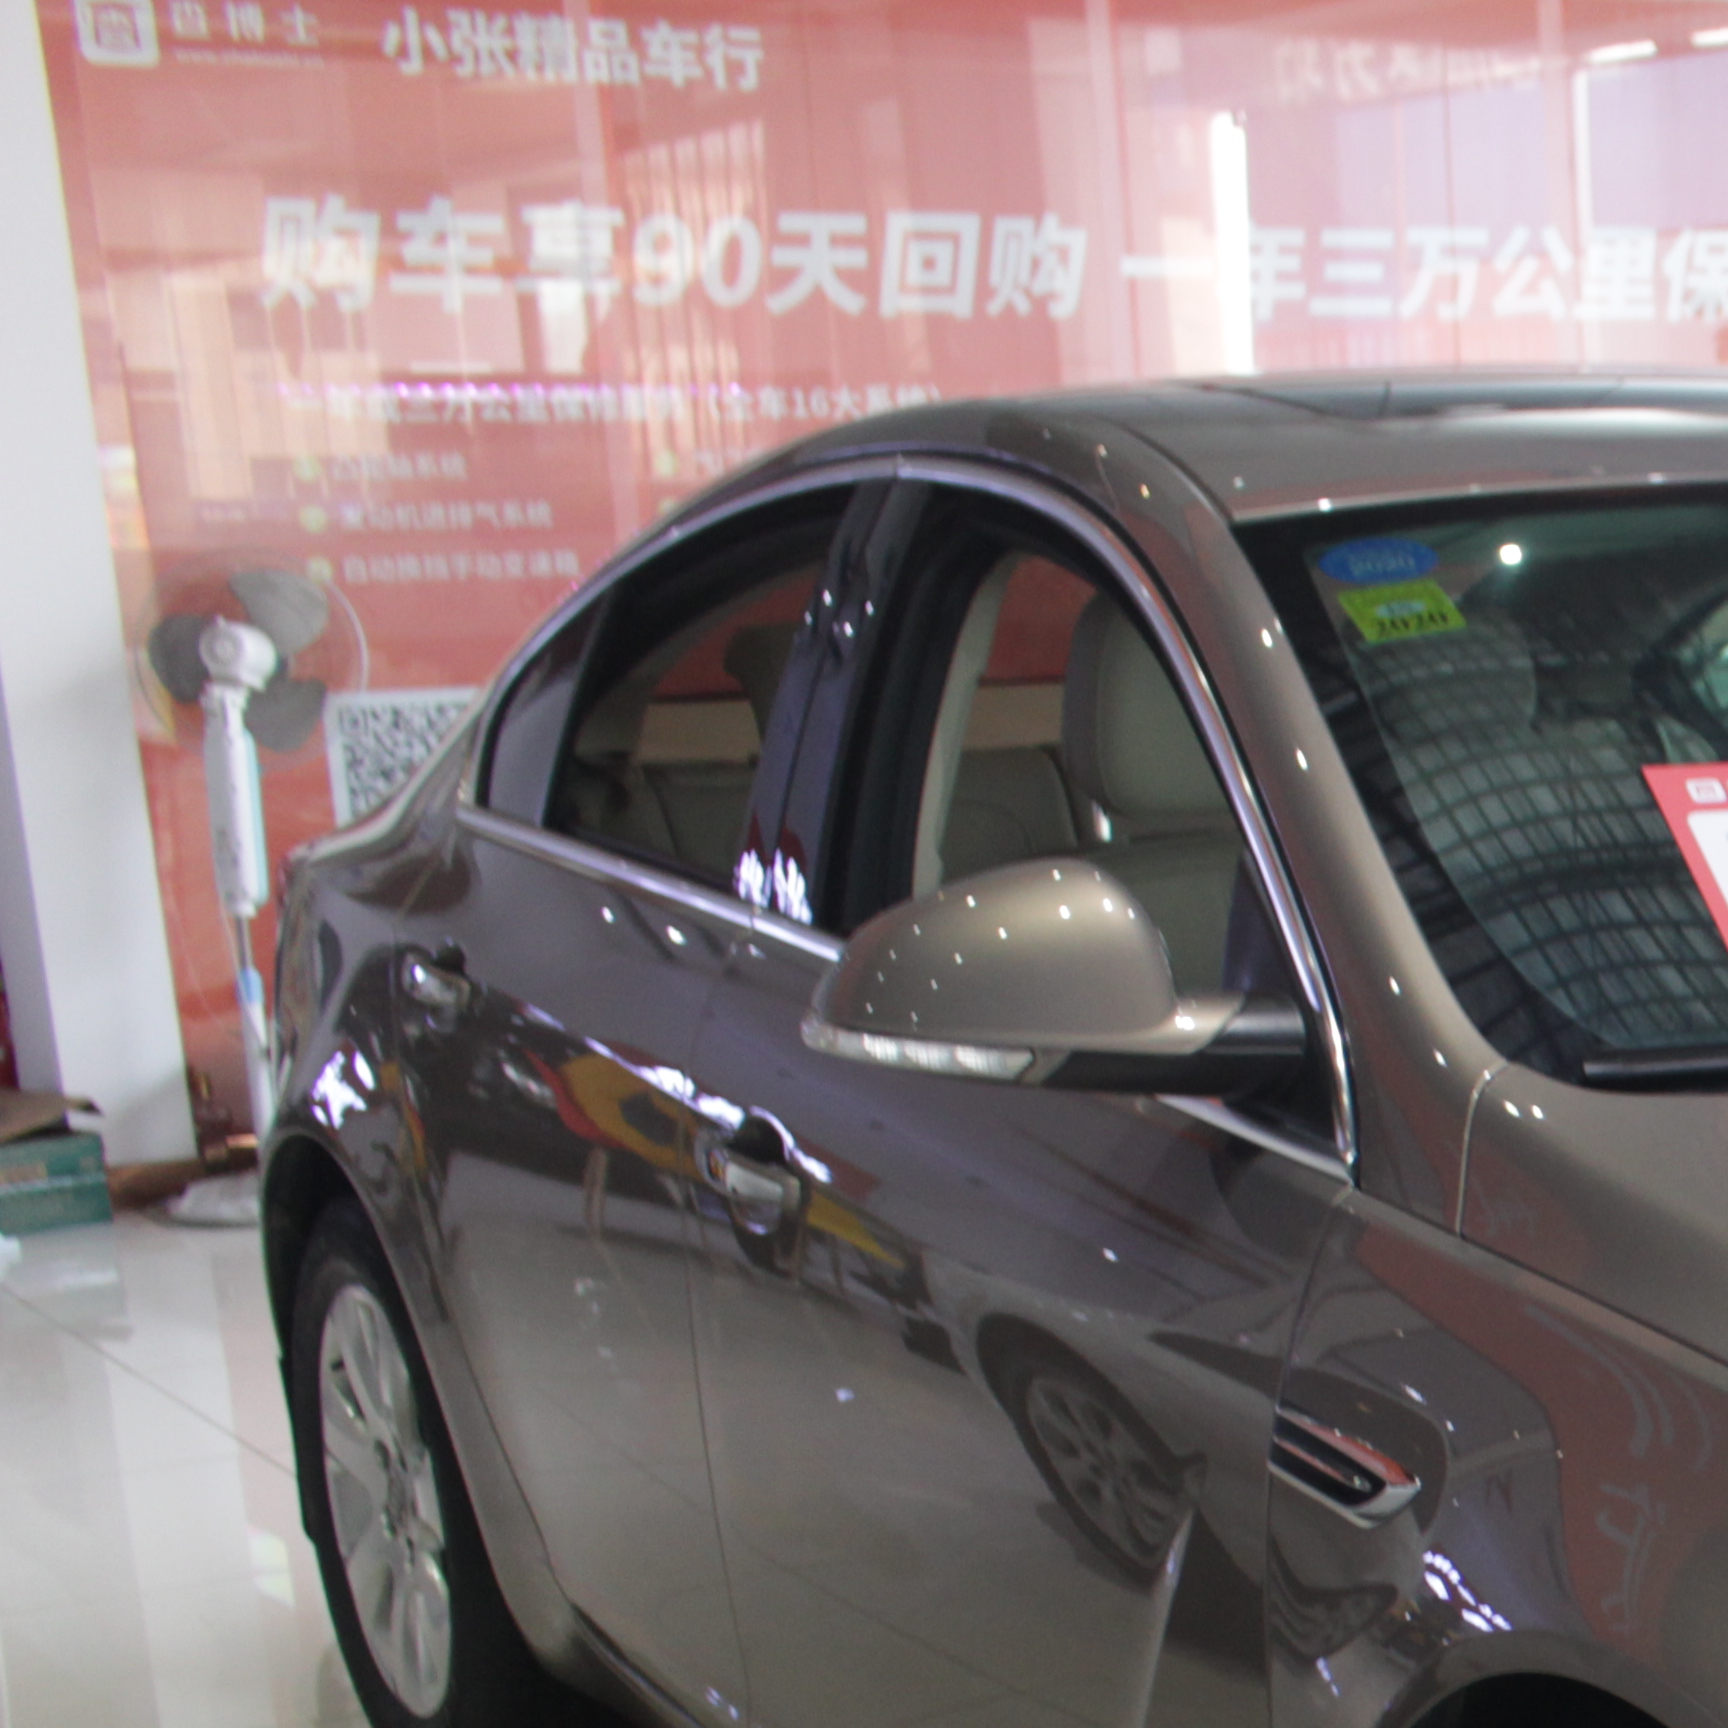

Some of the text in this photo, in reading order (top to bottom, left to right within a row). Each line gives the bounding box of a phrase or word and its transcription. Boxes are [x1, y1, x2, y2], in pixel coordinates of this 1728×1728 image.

[382, 6, 764, 93] 小张精品车行
[262, 195, 1088, 320] 购车享90天回购
